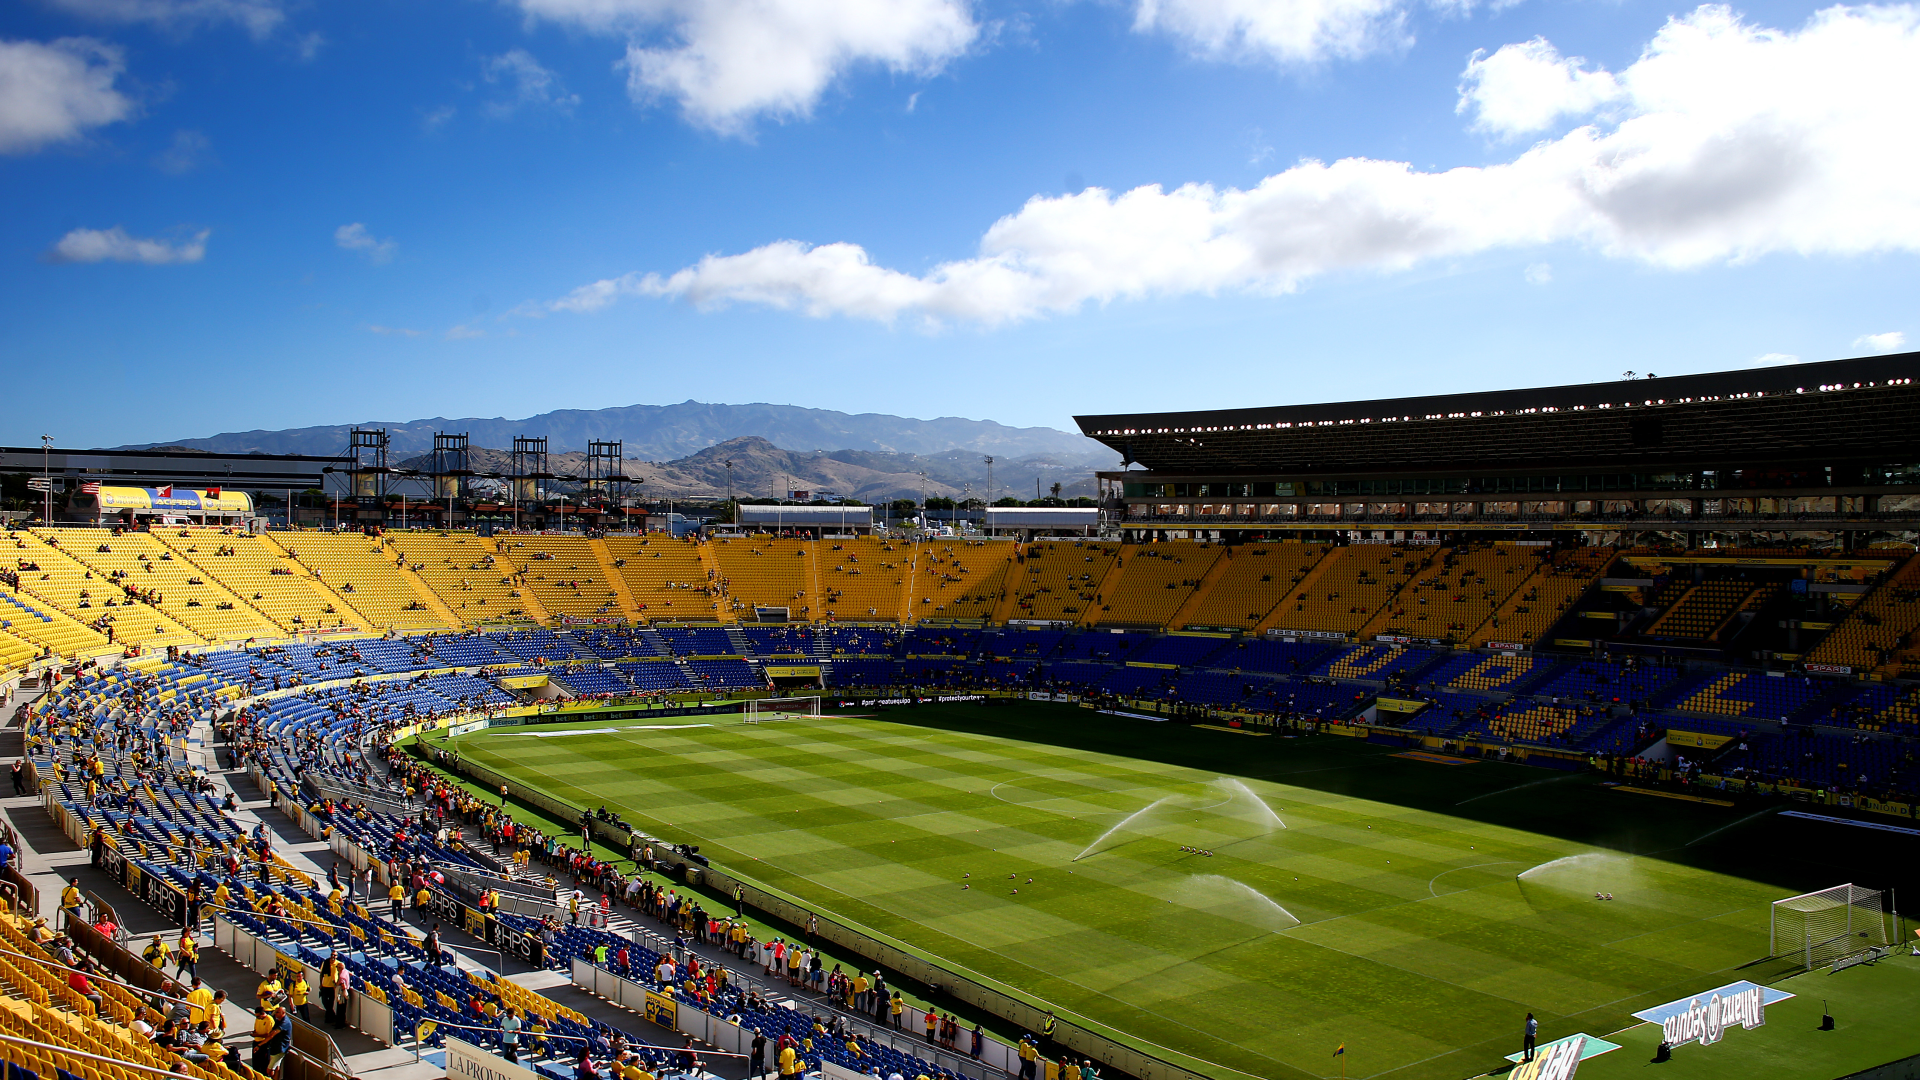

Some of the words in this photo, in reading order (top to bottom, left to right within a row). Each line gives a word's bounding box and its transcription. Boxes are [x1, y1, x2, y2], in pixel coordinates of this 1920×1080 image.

[1812, 664, 1840, 673] SPAR
[490, 718, 518, 726] AirEuropa
[105, 847, 121, 875] HPS
[153, 880, 176, 913] HPS
[434, 892, 457, 919] HPS
[502, 926, 531, 957] HPS
[1663, 998, 1708, 1046] Seguros
[1721, 986, 1761, 1030] Allianz
[450, 1052, 465, 1074] LA
